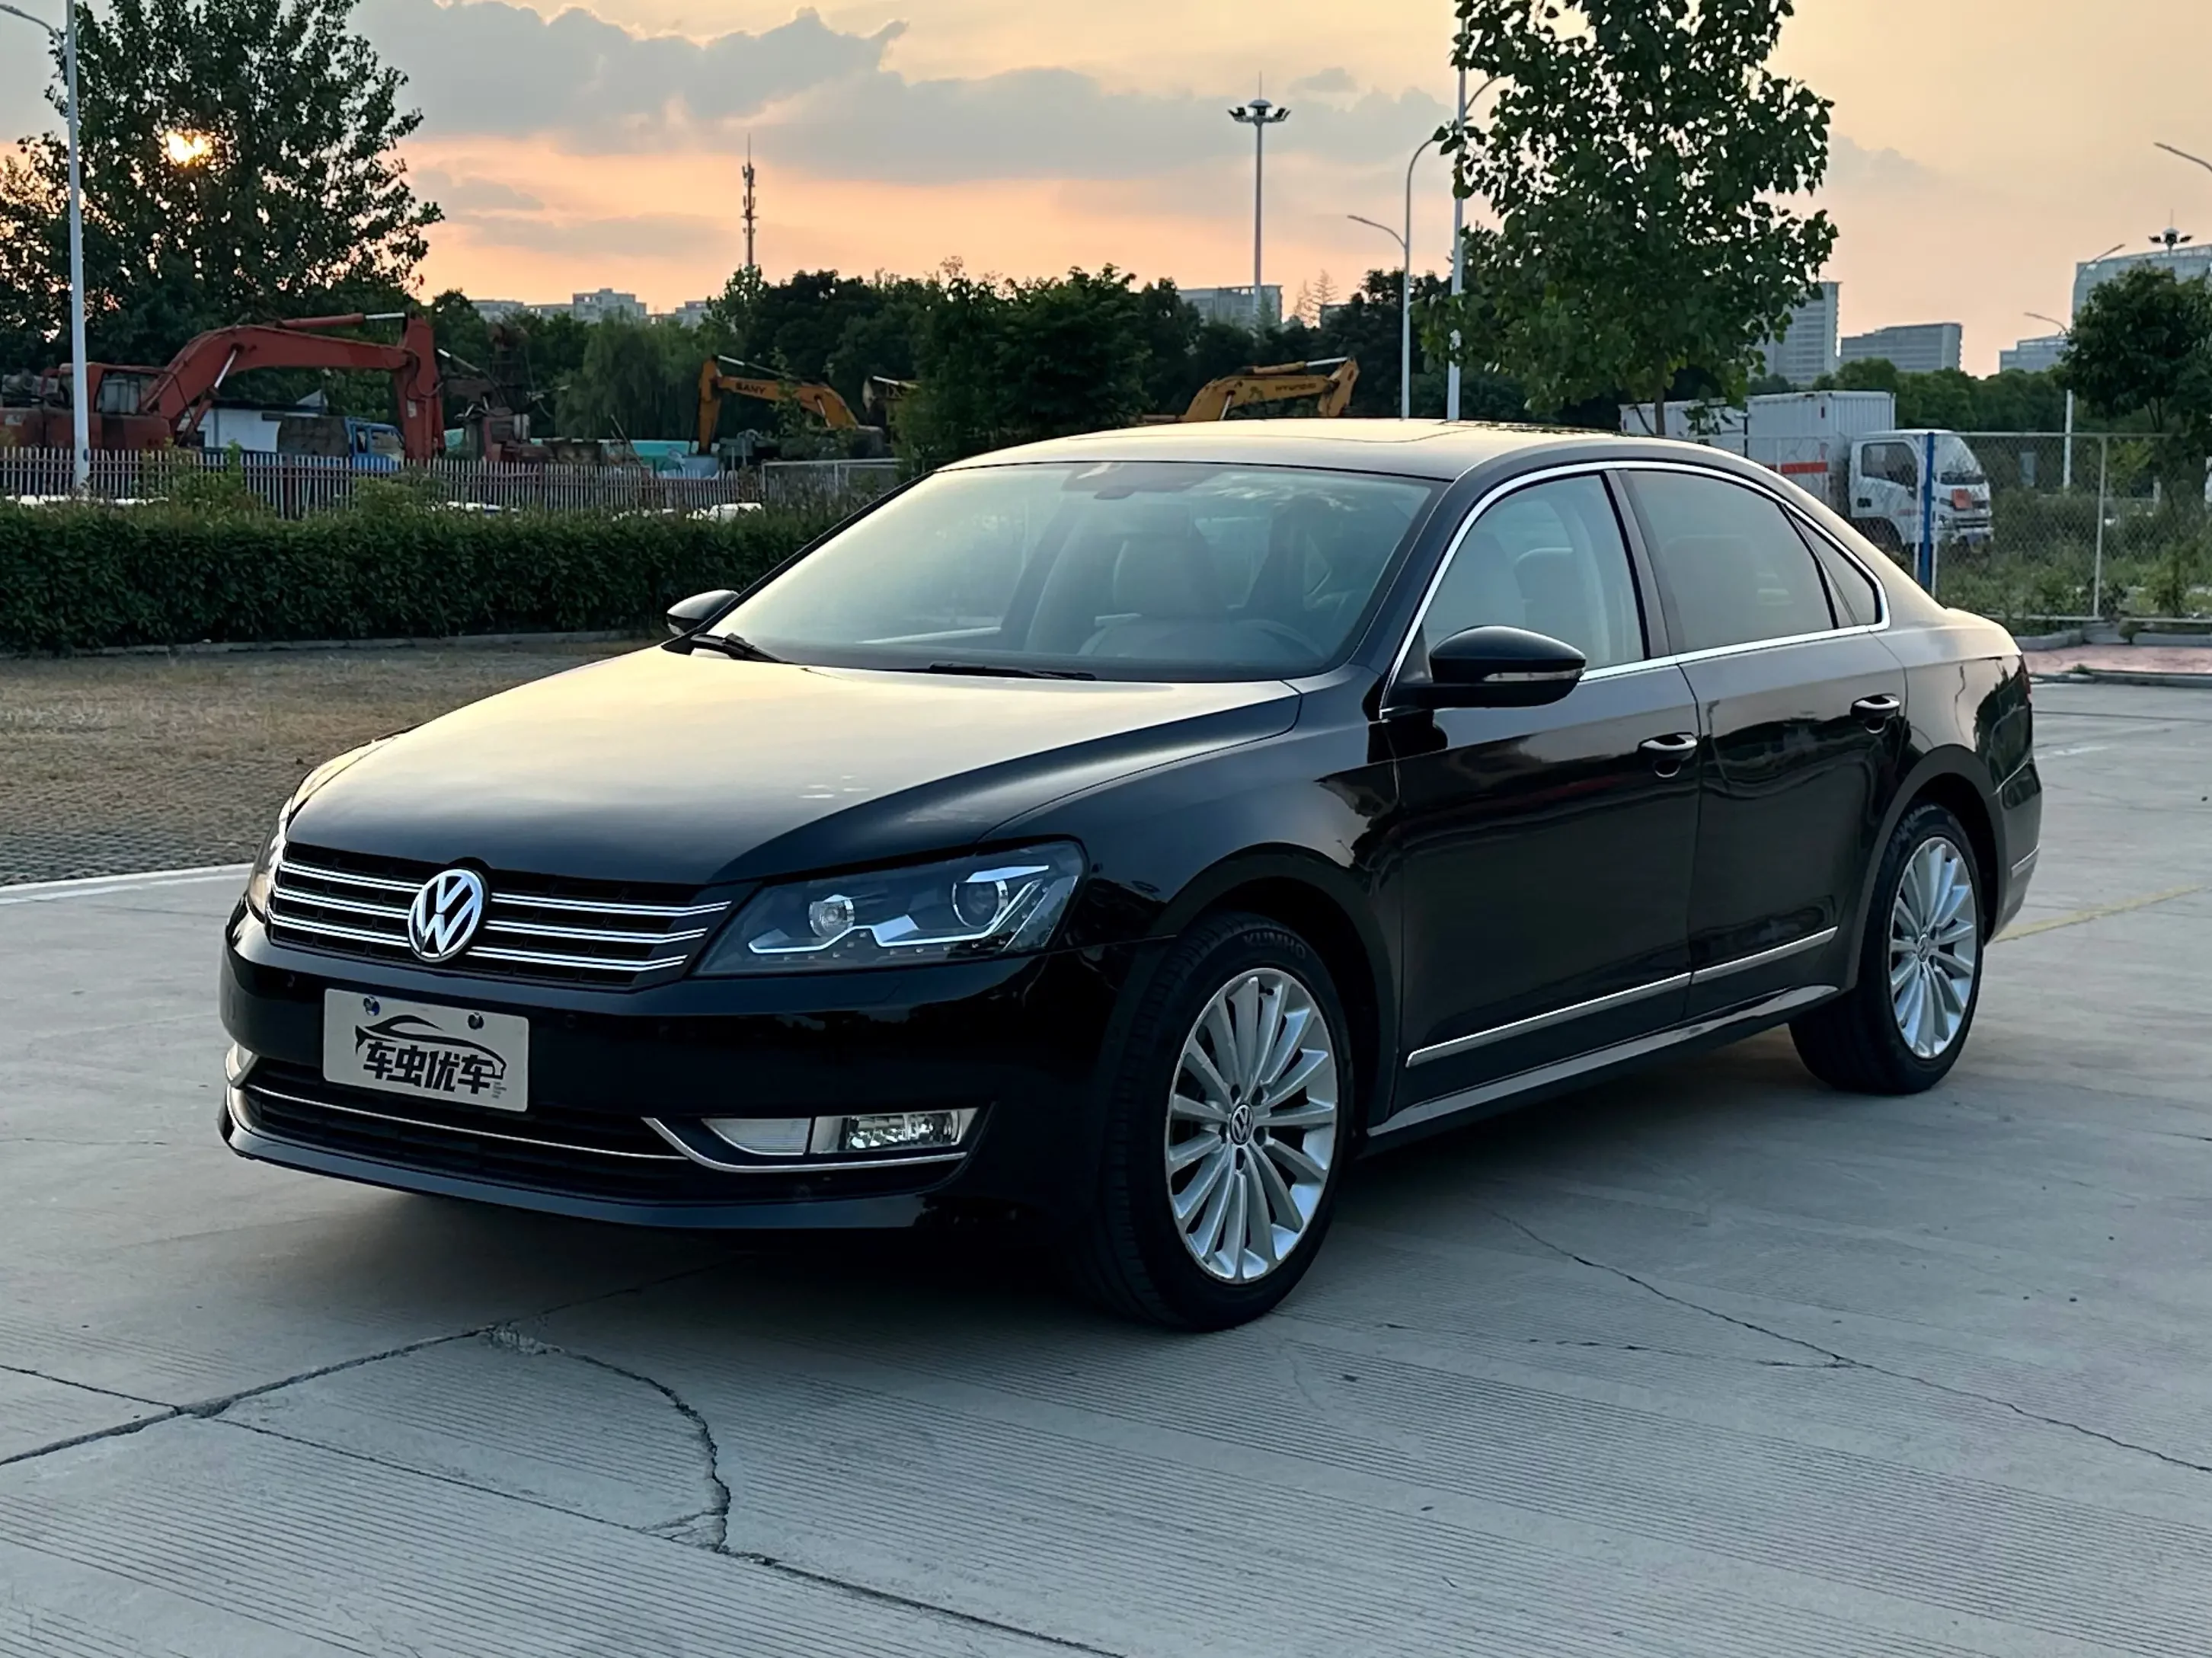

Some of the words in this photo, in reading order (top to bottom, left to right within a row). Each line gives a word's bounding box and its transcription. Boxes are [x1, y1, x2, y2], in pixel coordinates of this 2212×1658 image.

[411, 871, 481, 957] VW
[1242, 931, 1306, 960] KUMHO
[363, 1040, 494, 1095] 车虫优车
